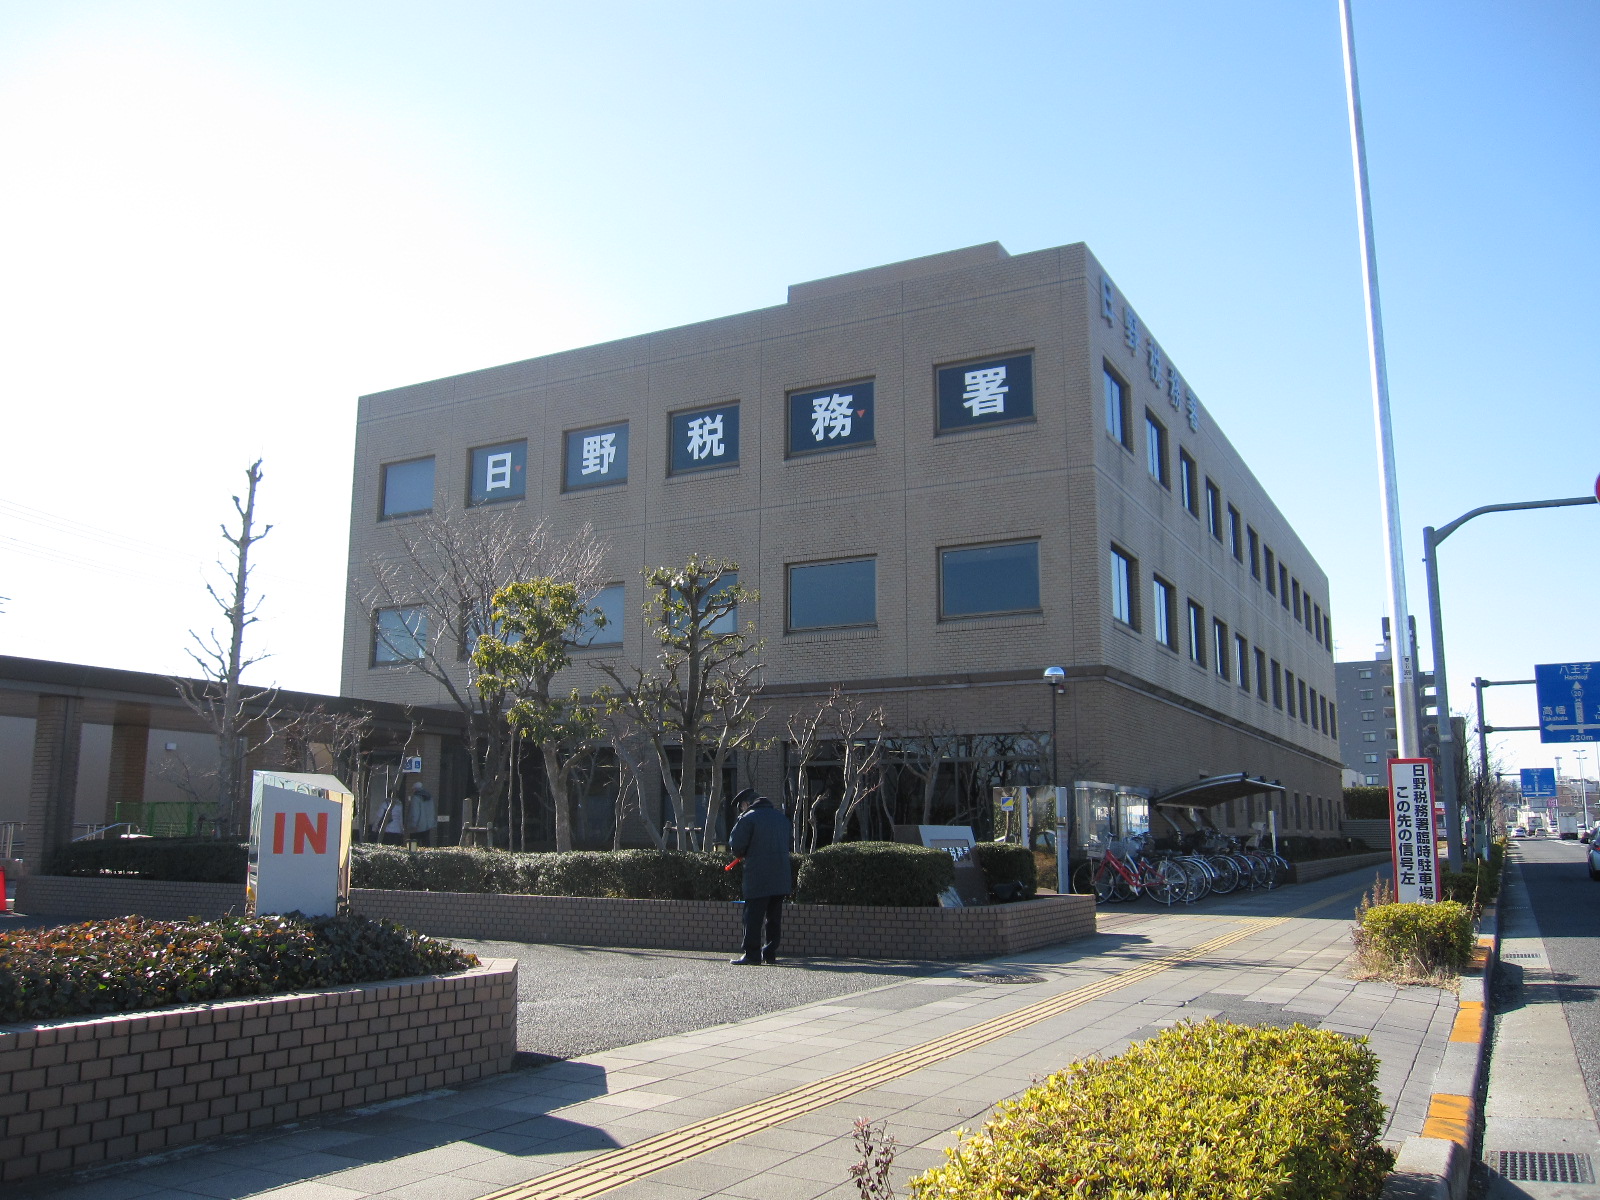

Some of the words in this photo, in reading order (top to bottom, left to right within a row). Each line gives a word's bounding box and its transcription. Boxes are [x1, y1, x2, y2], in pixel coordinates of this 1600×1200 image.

[1560, 664, 1592, 674] 八王子
[272, 812, 329, 855] IN
[1396, 786, 1416, 886] この先の信号左
[1412, 764, 1433, 900] 日野税務署臨時駐車場
